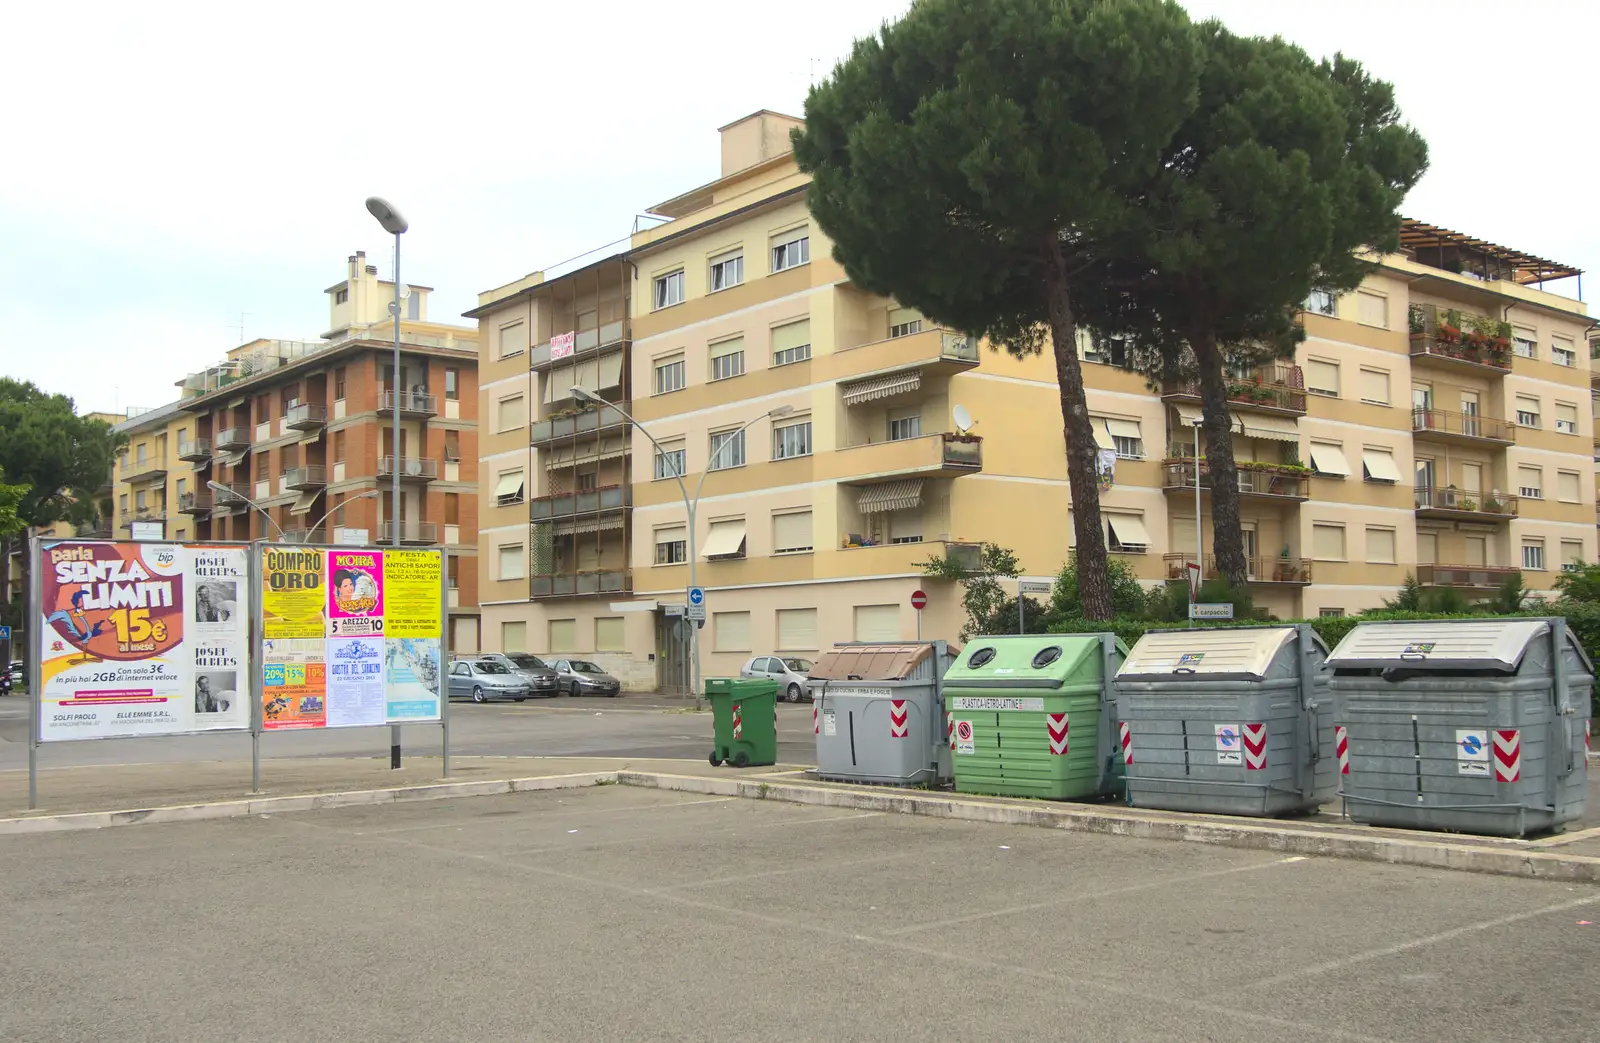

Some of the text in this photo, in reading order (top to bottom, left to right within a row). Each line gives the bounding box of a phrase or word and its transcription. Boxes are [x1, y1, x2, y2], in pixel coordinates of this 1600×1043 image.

[51, 546, 94, 564] parla
[158, 552, 174, 563] bip
[195, 557, 228, 568] JOSEF
[268, 552, 321, 571] COMPRO
[336, 555, 376, 568] MOIRA
[55, 559, 150, 584] SENZA
[270, 572, 319, 589] ORO
[81, 581, 173, 610] LIMITI
[108, 608, 167, 643] 15€
[332, 620, 338, 634] 5
[342, 618, 370, 626] AREZZO
[370, 620, 383, 632] 10
[119, 643, 155, 652] al mese
[195, 648, 228, 658] JOSEF
[149, 664, 164, 674] 3€
[265, 669, 284, 680] 20%
[286, 669, 304, 678] 15%
[308, 668, 324, 678] 10%
[92, 672, 116, 682] 2GB
[124, 673, 154, 681] internet
[154, 673, 178, 681] veloce
[962, 698, 1018, 709] PLASTICA-VETRO-LATTINE
